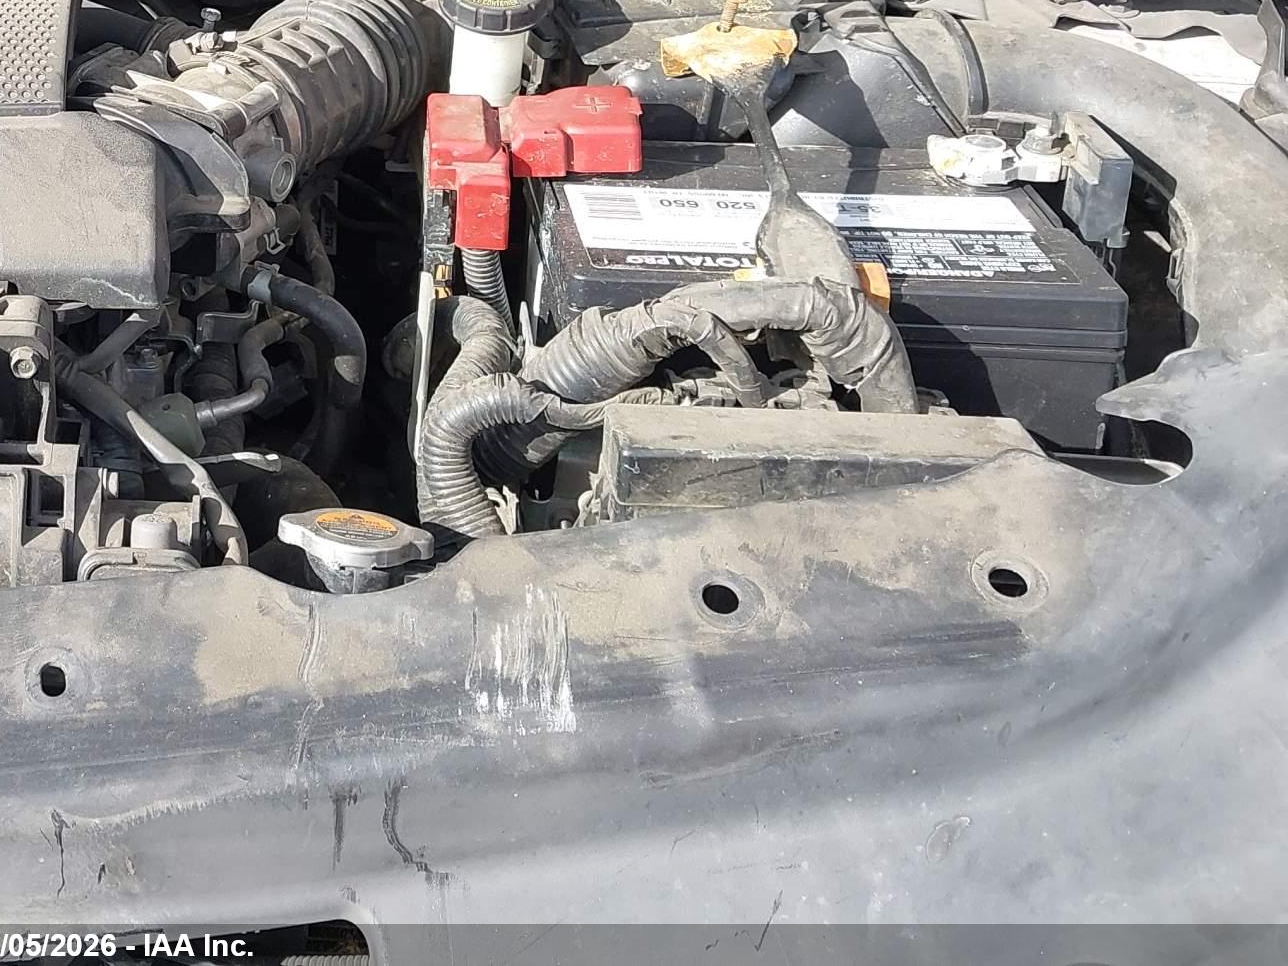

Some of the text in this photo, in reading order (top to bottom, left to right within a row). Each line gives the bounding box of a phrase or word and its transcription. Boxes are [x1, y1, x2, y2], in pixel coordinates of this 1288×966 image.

[659, 199, 699, 208] 650
[716, 200, 756, 210] 520
[625, 254, 756, 268] TOTALPRO
